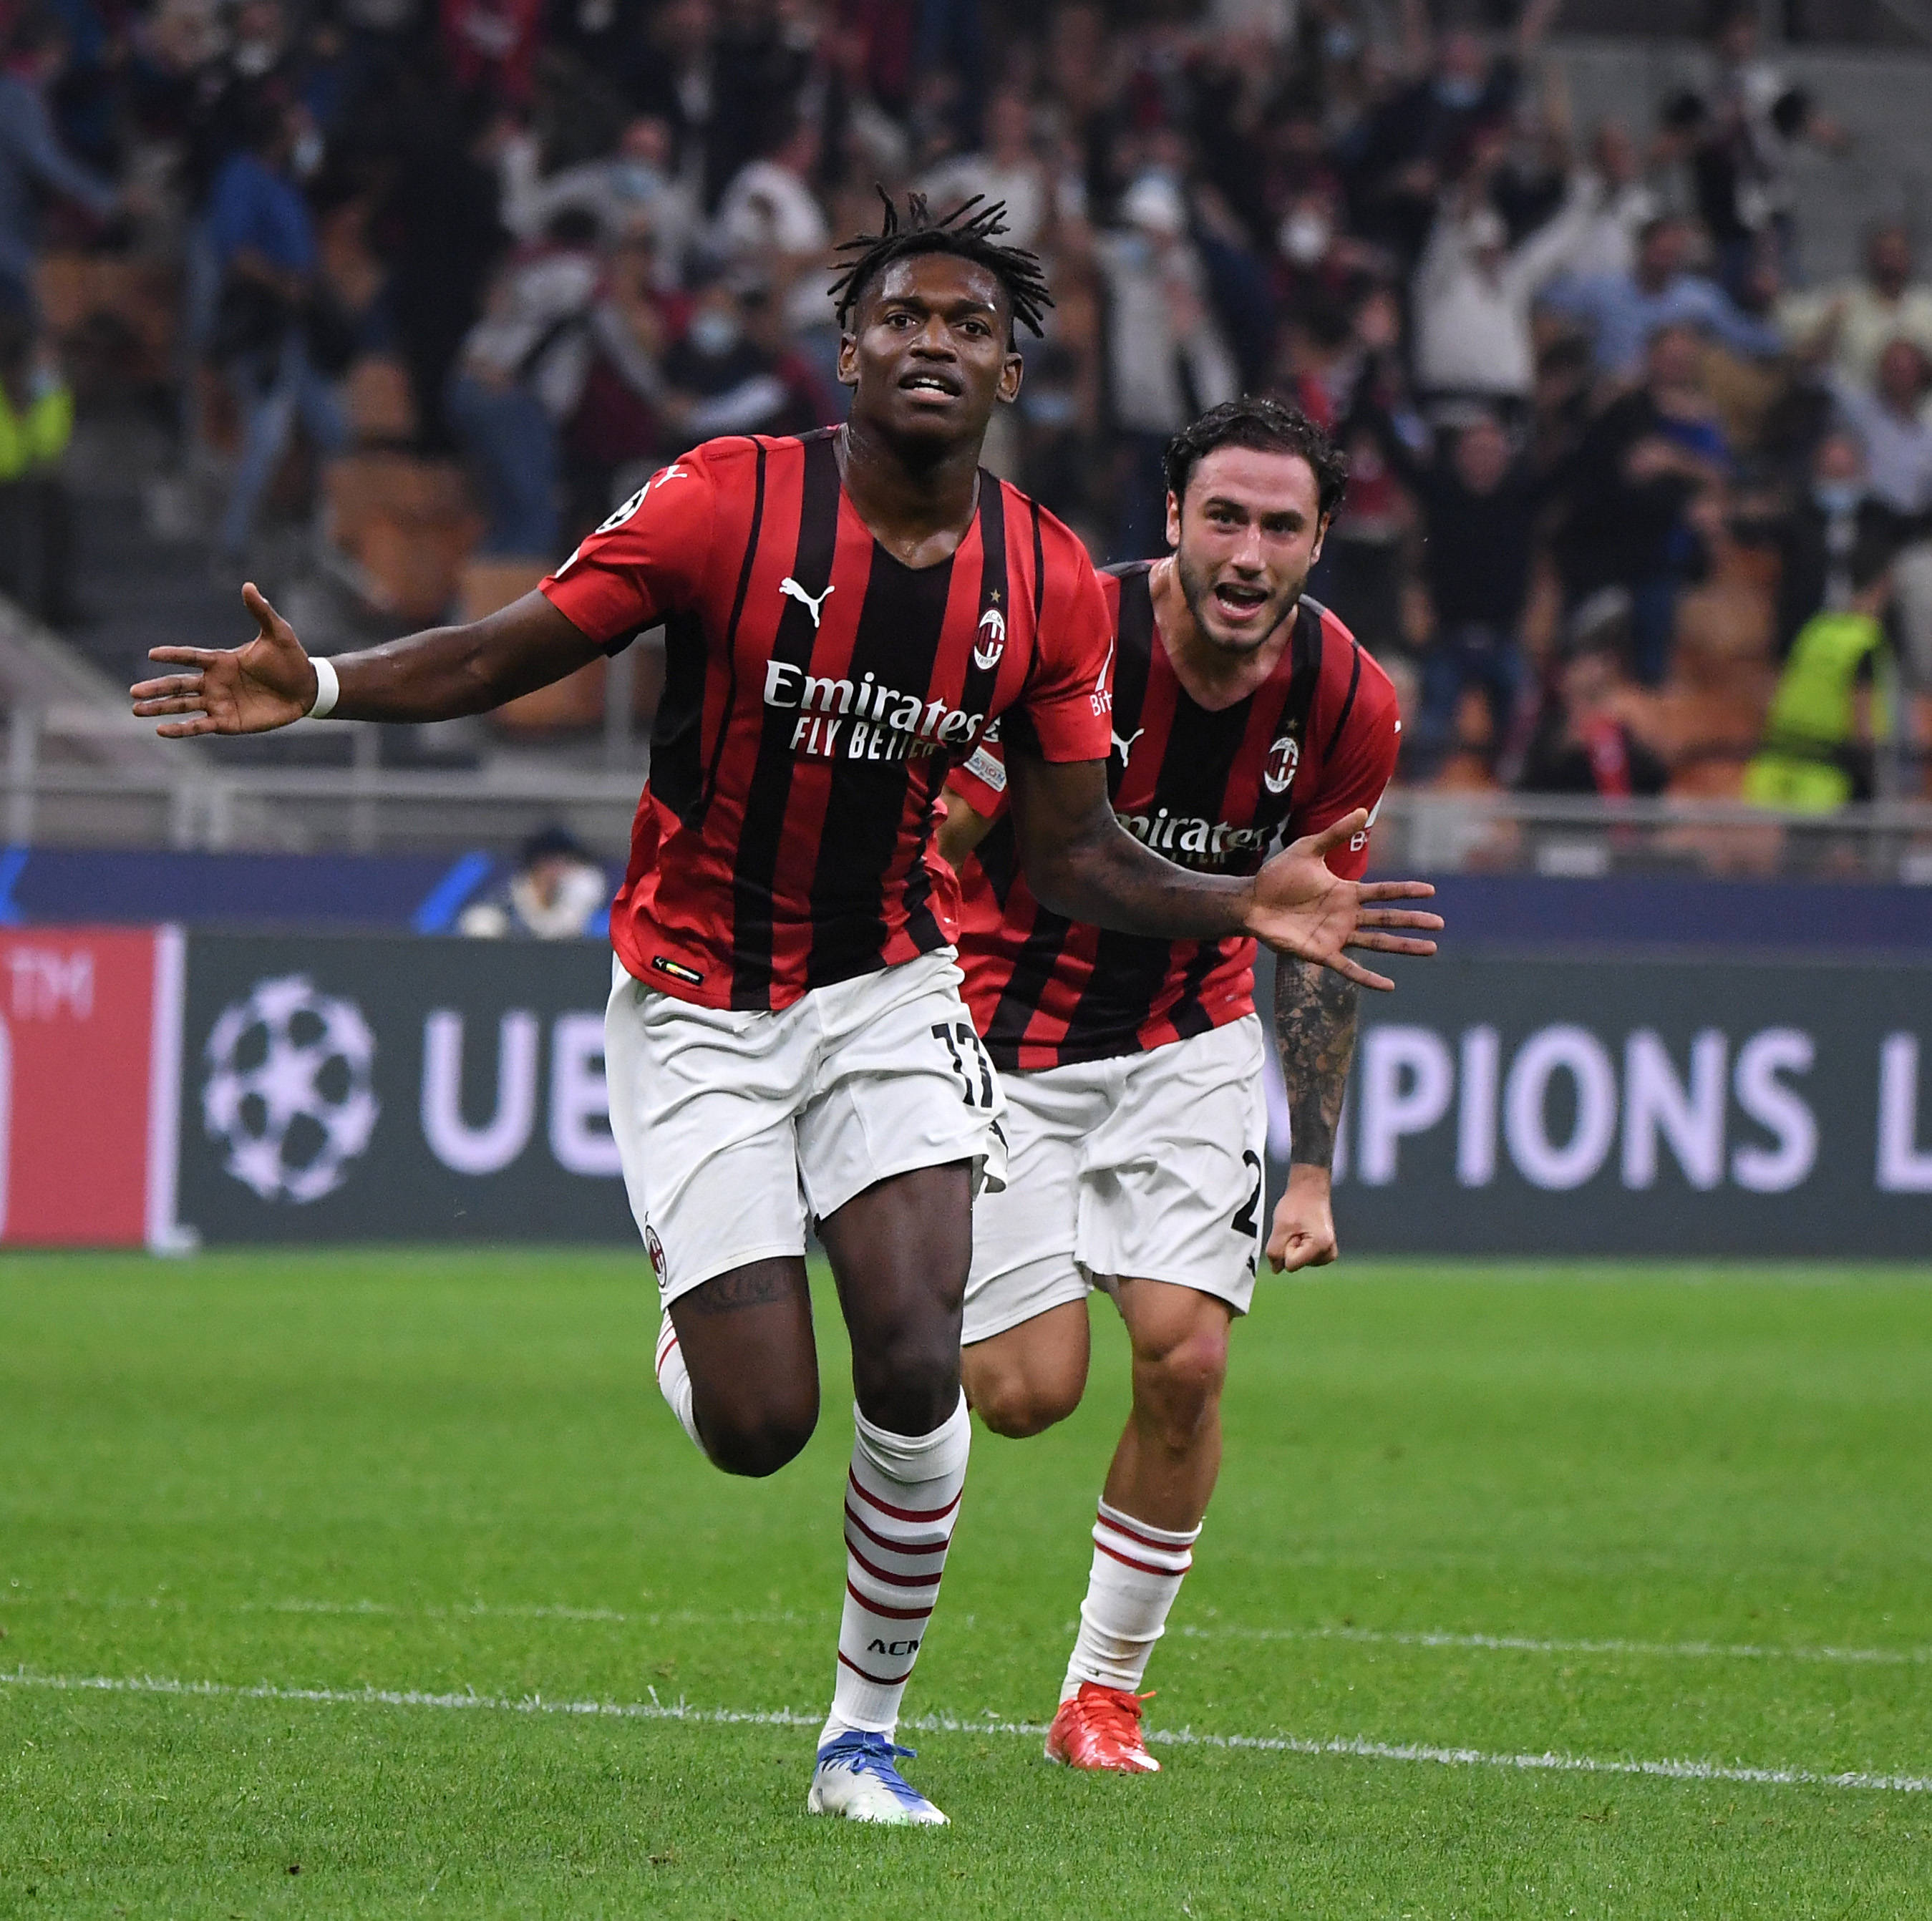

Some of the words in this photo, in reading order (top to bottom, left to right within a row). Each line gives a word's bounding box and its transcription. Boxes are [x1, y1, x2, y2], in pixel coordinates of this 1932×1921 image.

[764, 660, 984, 743] Emirates
[789, 717, 843, 757] FLY
[931, 1022, 993, 1108] 17
[1230, 1149, 1261, 1239] 2
